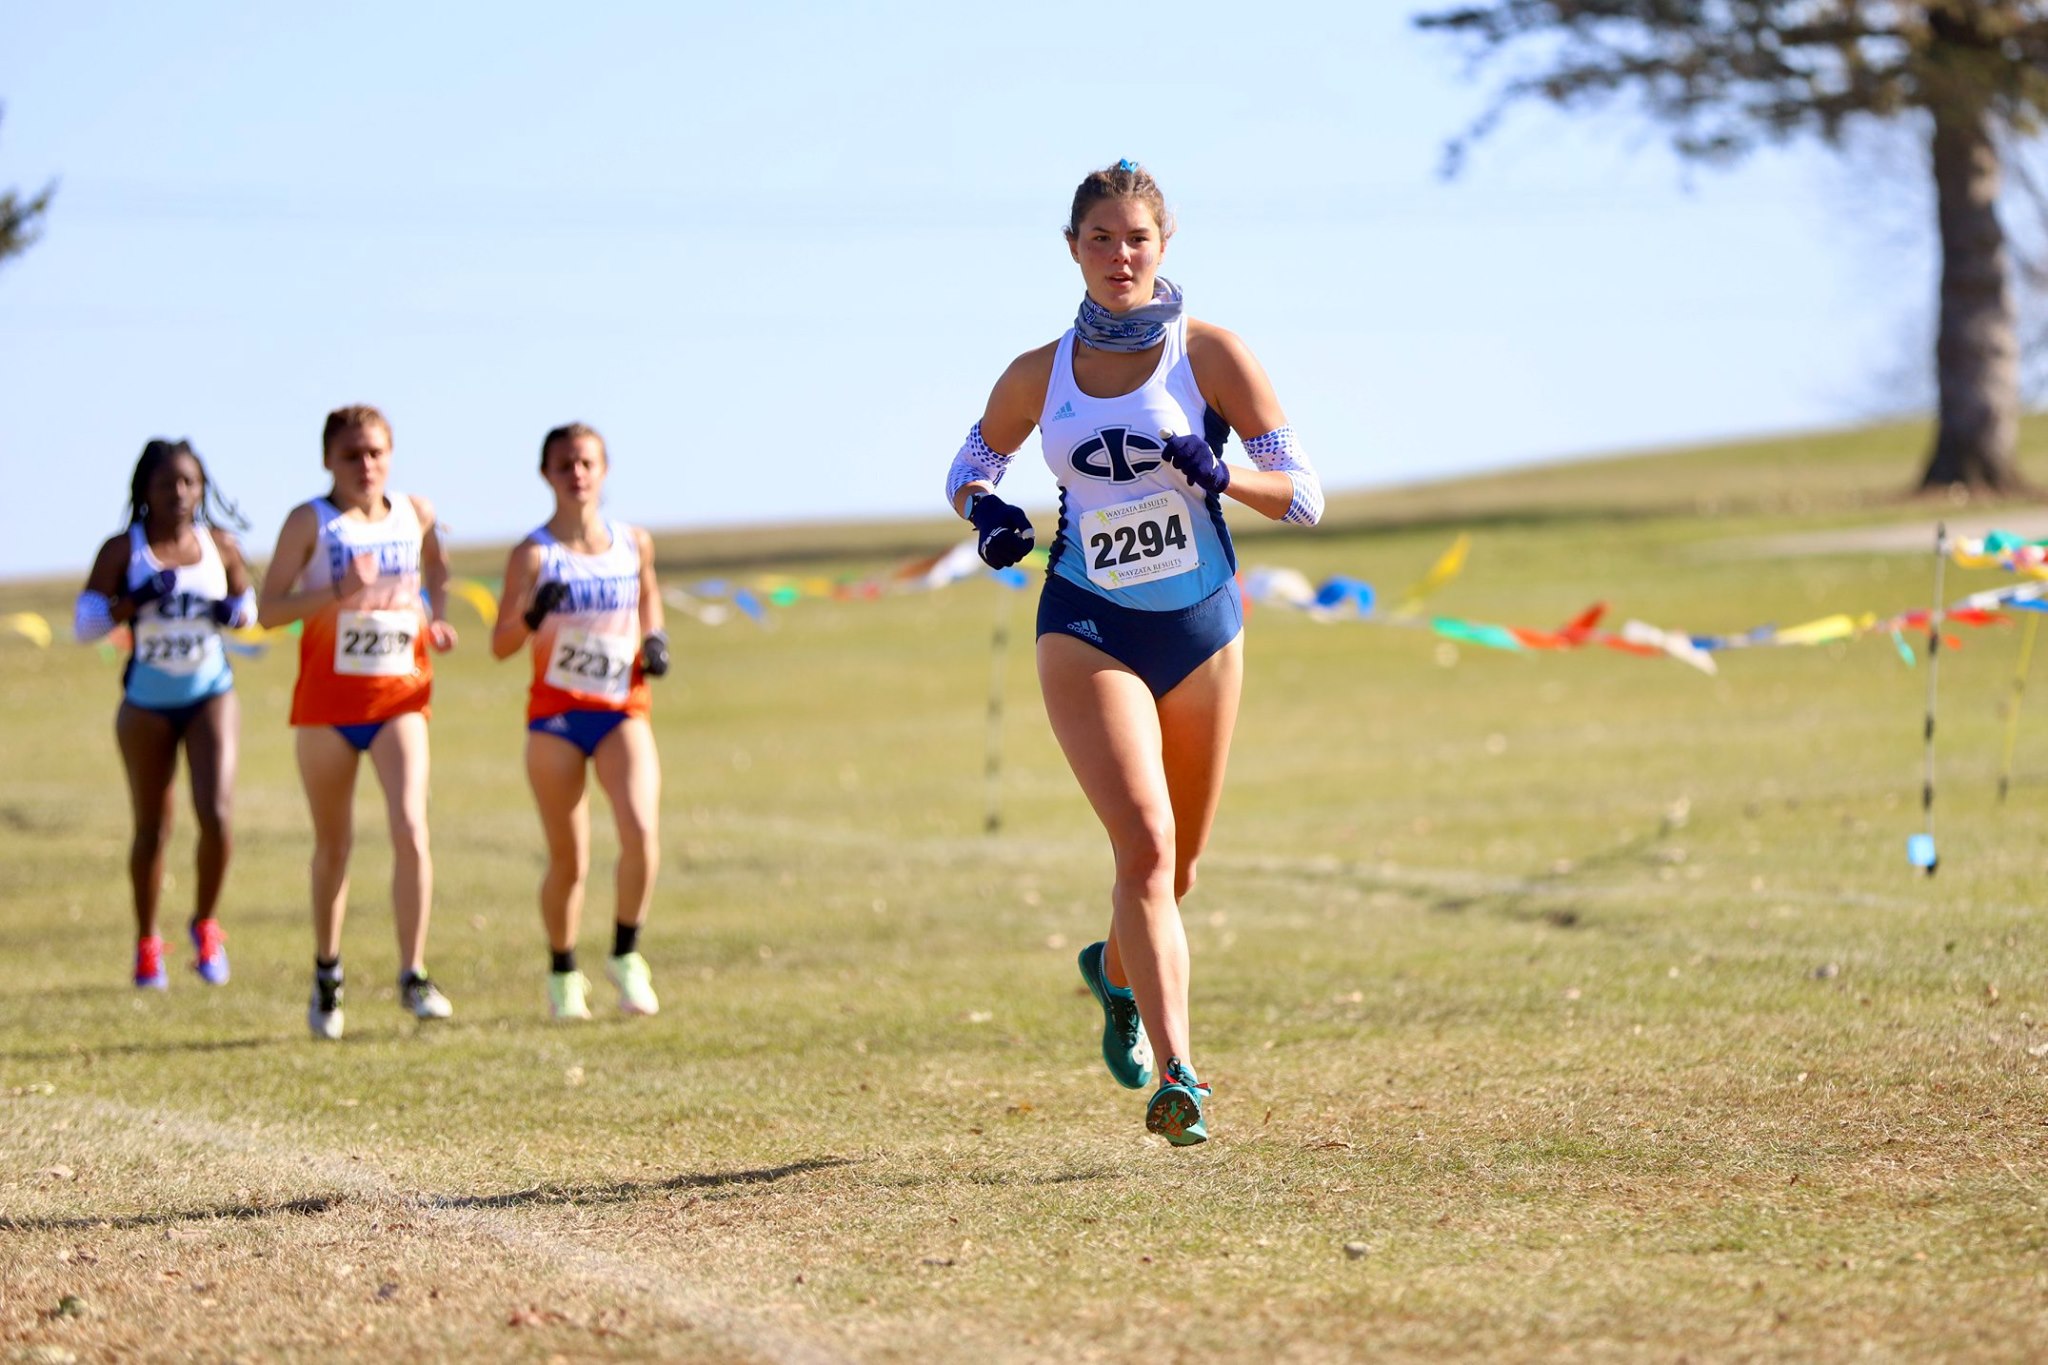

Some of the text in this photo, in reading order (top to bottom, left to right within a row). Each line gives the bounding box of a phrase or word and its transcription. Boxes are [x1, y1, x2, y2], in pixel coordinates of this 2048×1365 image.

[1105, 505, 1137, 518] WAYZATA
[1139, 498, 1168, 510] RESULTS
[1090, 514, 1187, 570] 2294
[1118, 566, 1152, 578] WAYZATA
[1153, 559, 1182, 571] RESULTS
[1066, 623, 1104, 643] adidas
